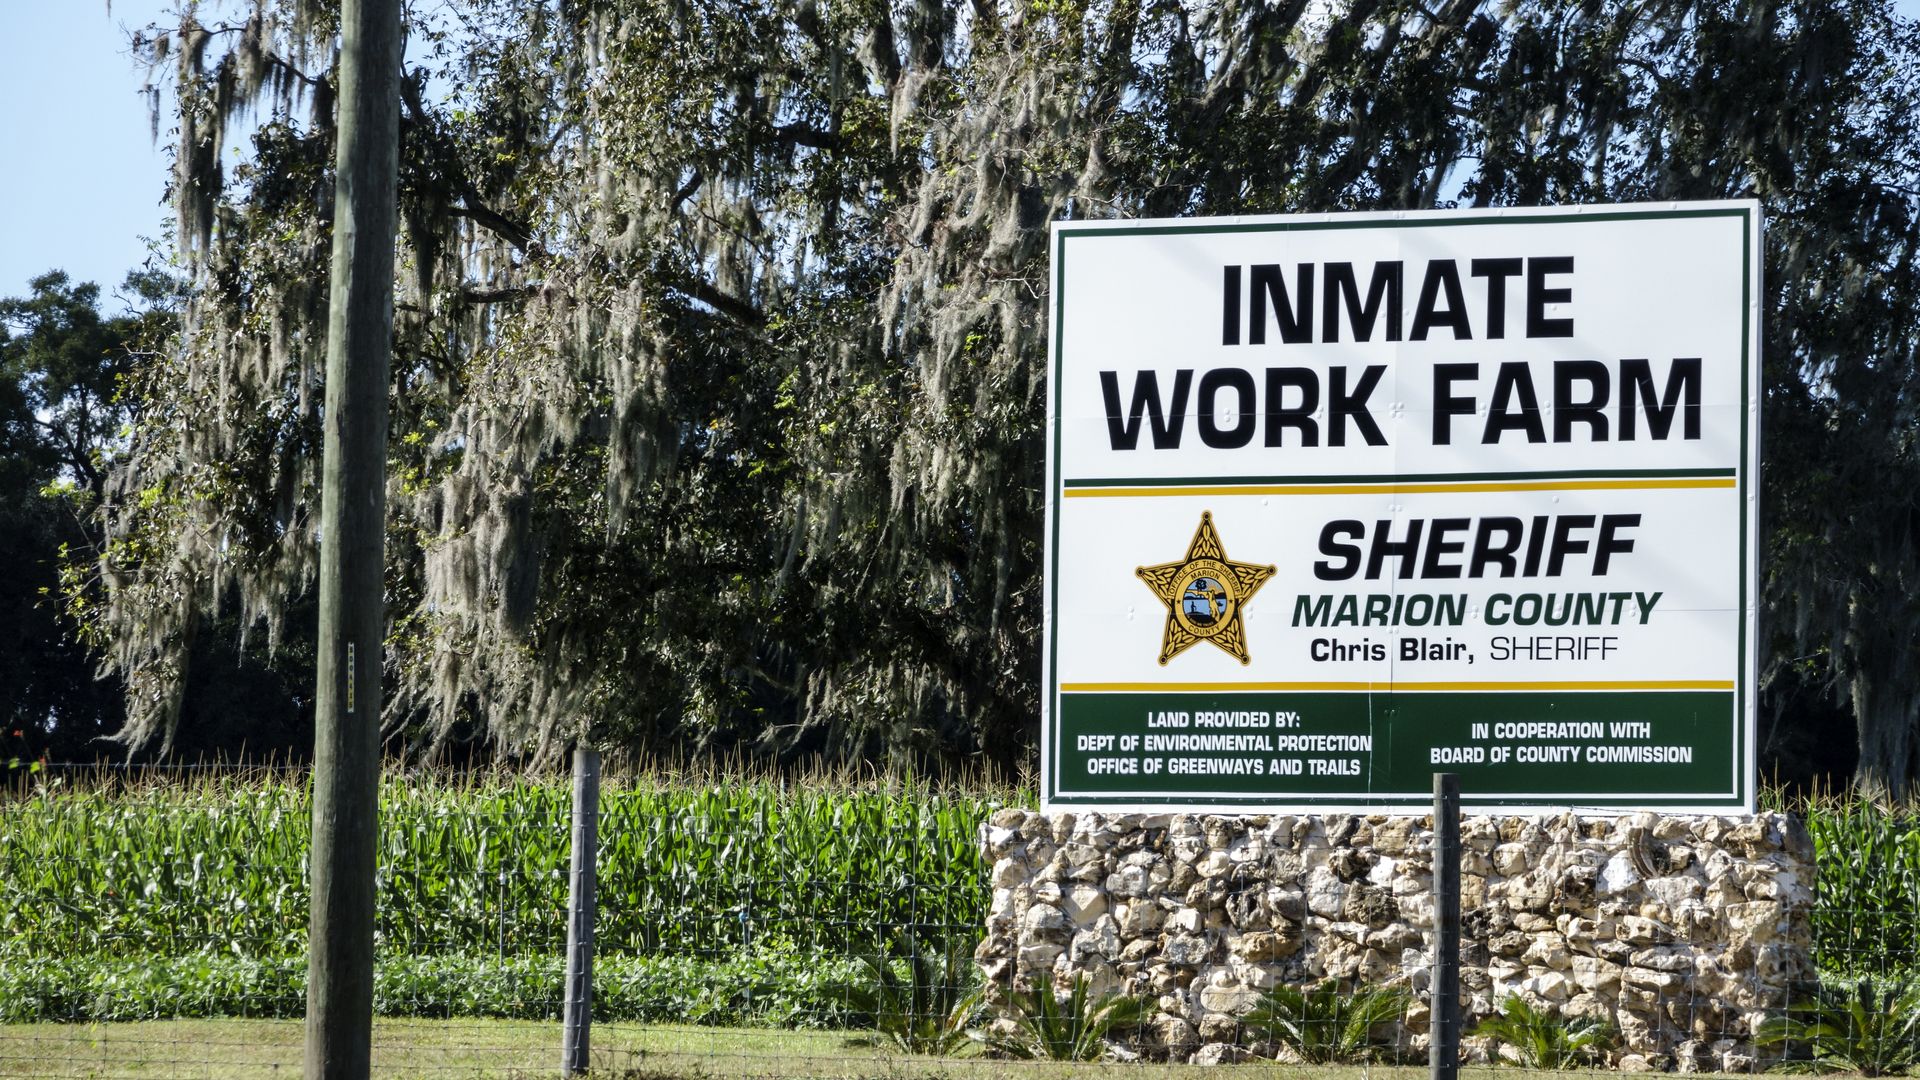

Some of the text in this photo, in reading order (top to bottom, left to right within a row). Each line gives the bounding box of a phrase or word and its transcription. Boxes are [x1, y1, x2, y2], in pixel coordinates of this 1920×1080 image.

[1223, 257, 1573, 345] INMATE
[1100, 358, 1701, 450] WORK FARM
[1314, 514, 1641, 580] SHERIFF
[1169, 569, 1188, 594] OFFICE
[1190, 561, 1200, 570] OF
[1202, 560, 1216, 568] THE
[1190, 570, 1221, 580] MARION
[1292, 592, 1662, 627] MARION COUNTY
[1188, 625, 1220, 635] COUNTY
[1311, 637, 1618, 665] Chris Blair, SHERIFF
[1147, 711, 1301, 728] LAND PROVIDED BY:
[1471, 721, 1651, 739] IN COOPERATION WITH
[1077, 734, 1373, 752] DEPT OF ENVIRONMENTAL PROTECTION
[1430, 745, 1693, 764] BOARD OF COUNTY COMMISSION
[1087, 757, 1361, 776] OFFICE OF GREENWAYS AND TRAILS
